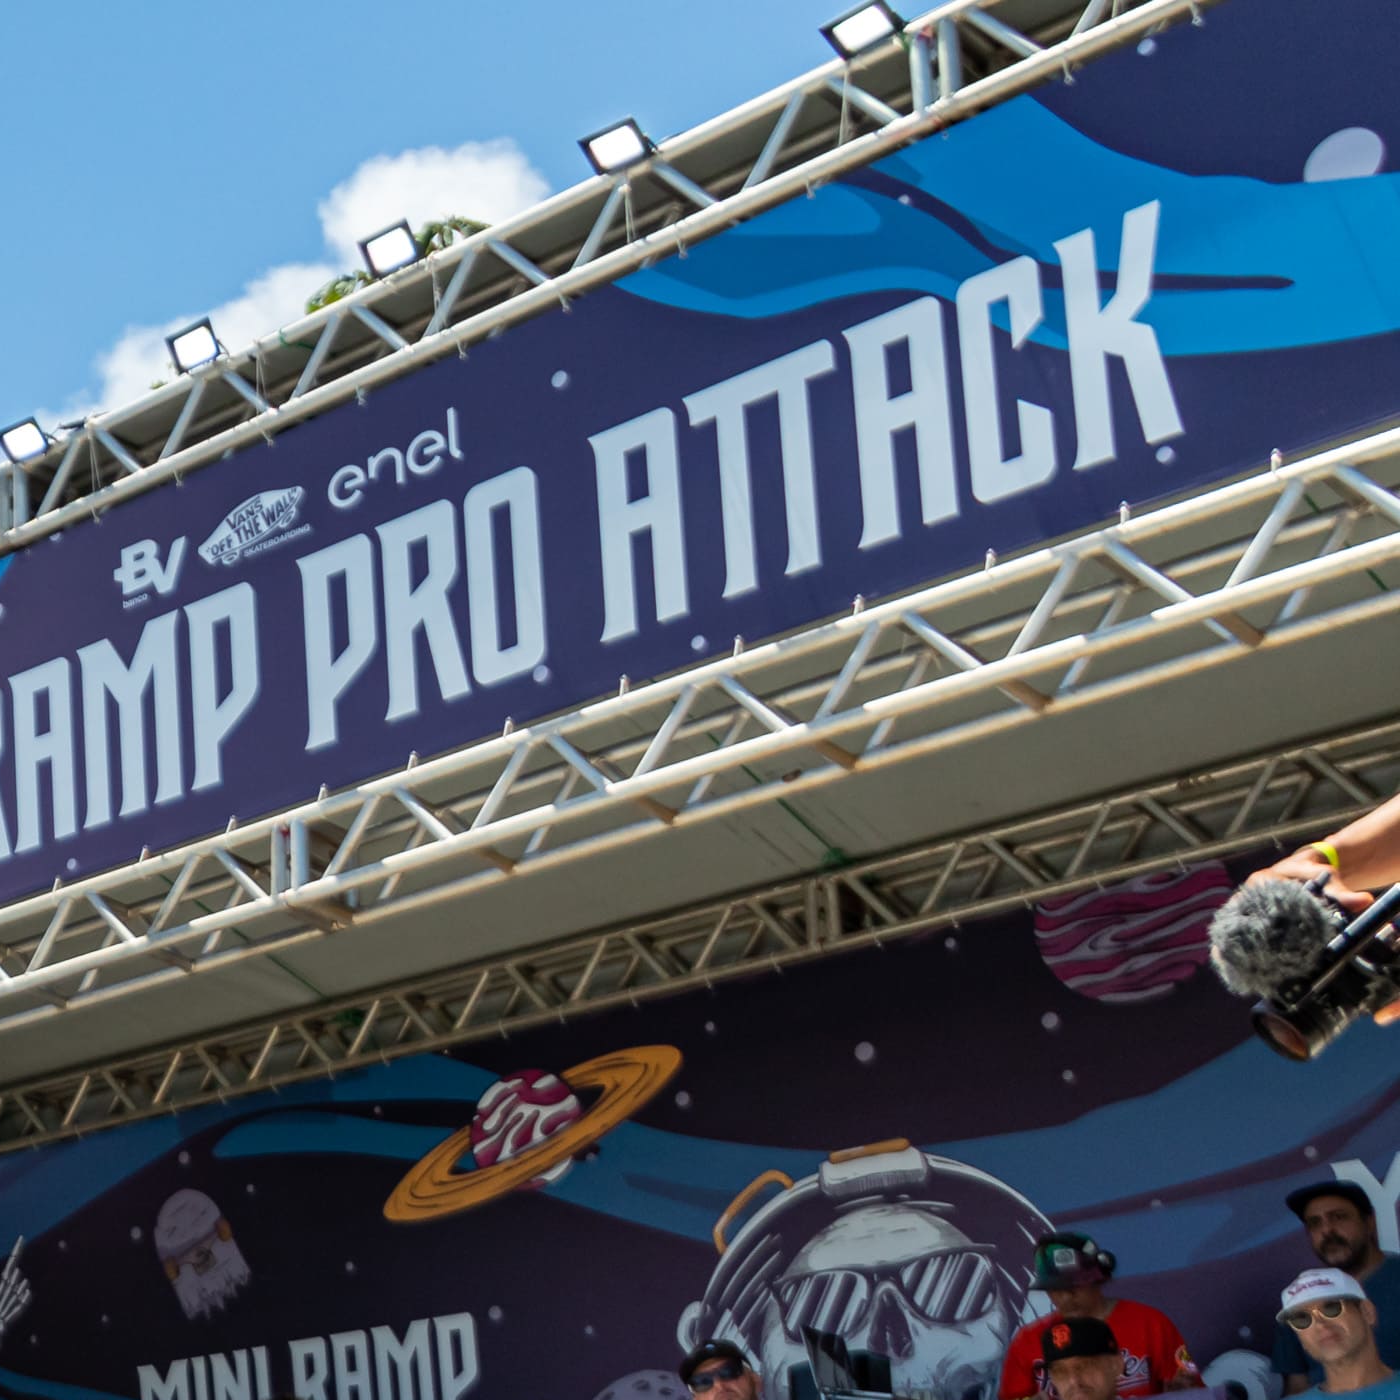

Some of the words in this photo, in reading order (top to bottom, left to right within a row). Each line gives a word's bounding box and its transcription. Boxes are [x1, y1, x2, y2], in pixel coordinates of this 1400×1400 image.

[297, 466, 546, 750] PRO
[590, 199, 1183, 644] ATTACK
[328, 407, 463, 508] enel
[226, 495, 263, 529] VANS
[234, 514, 262, 544] THE
[243, 523, 311, 557] SKATEBOARDING
[113, 535, 186, 596] BV
[122, 593, 148, 609] banco
